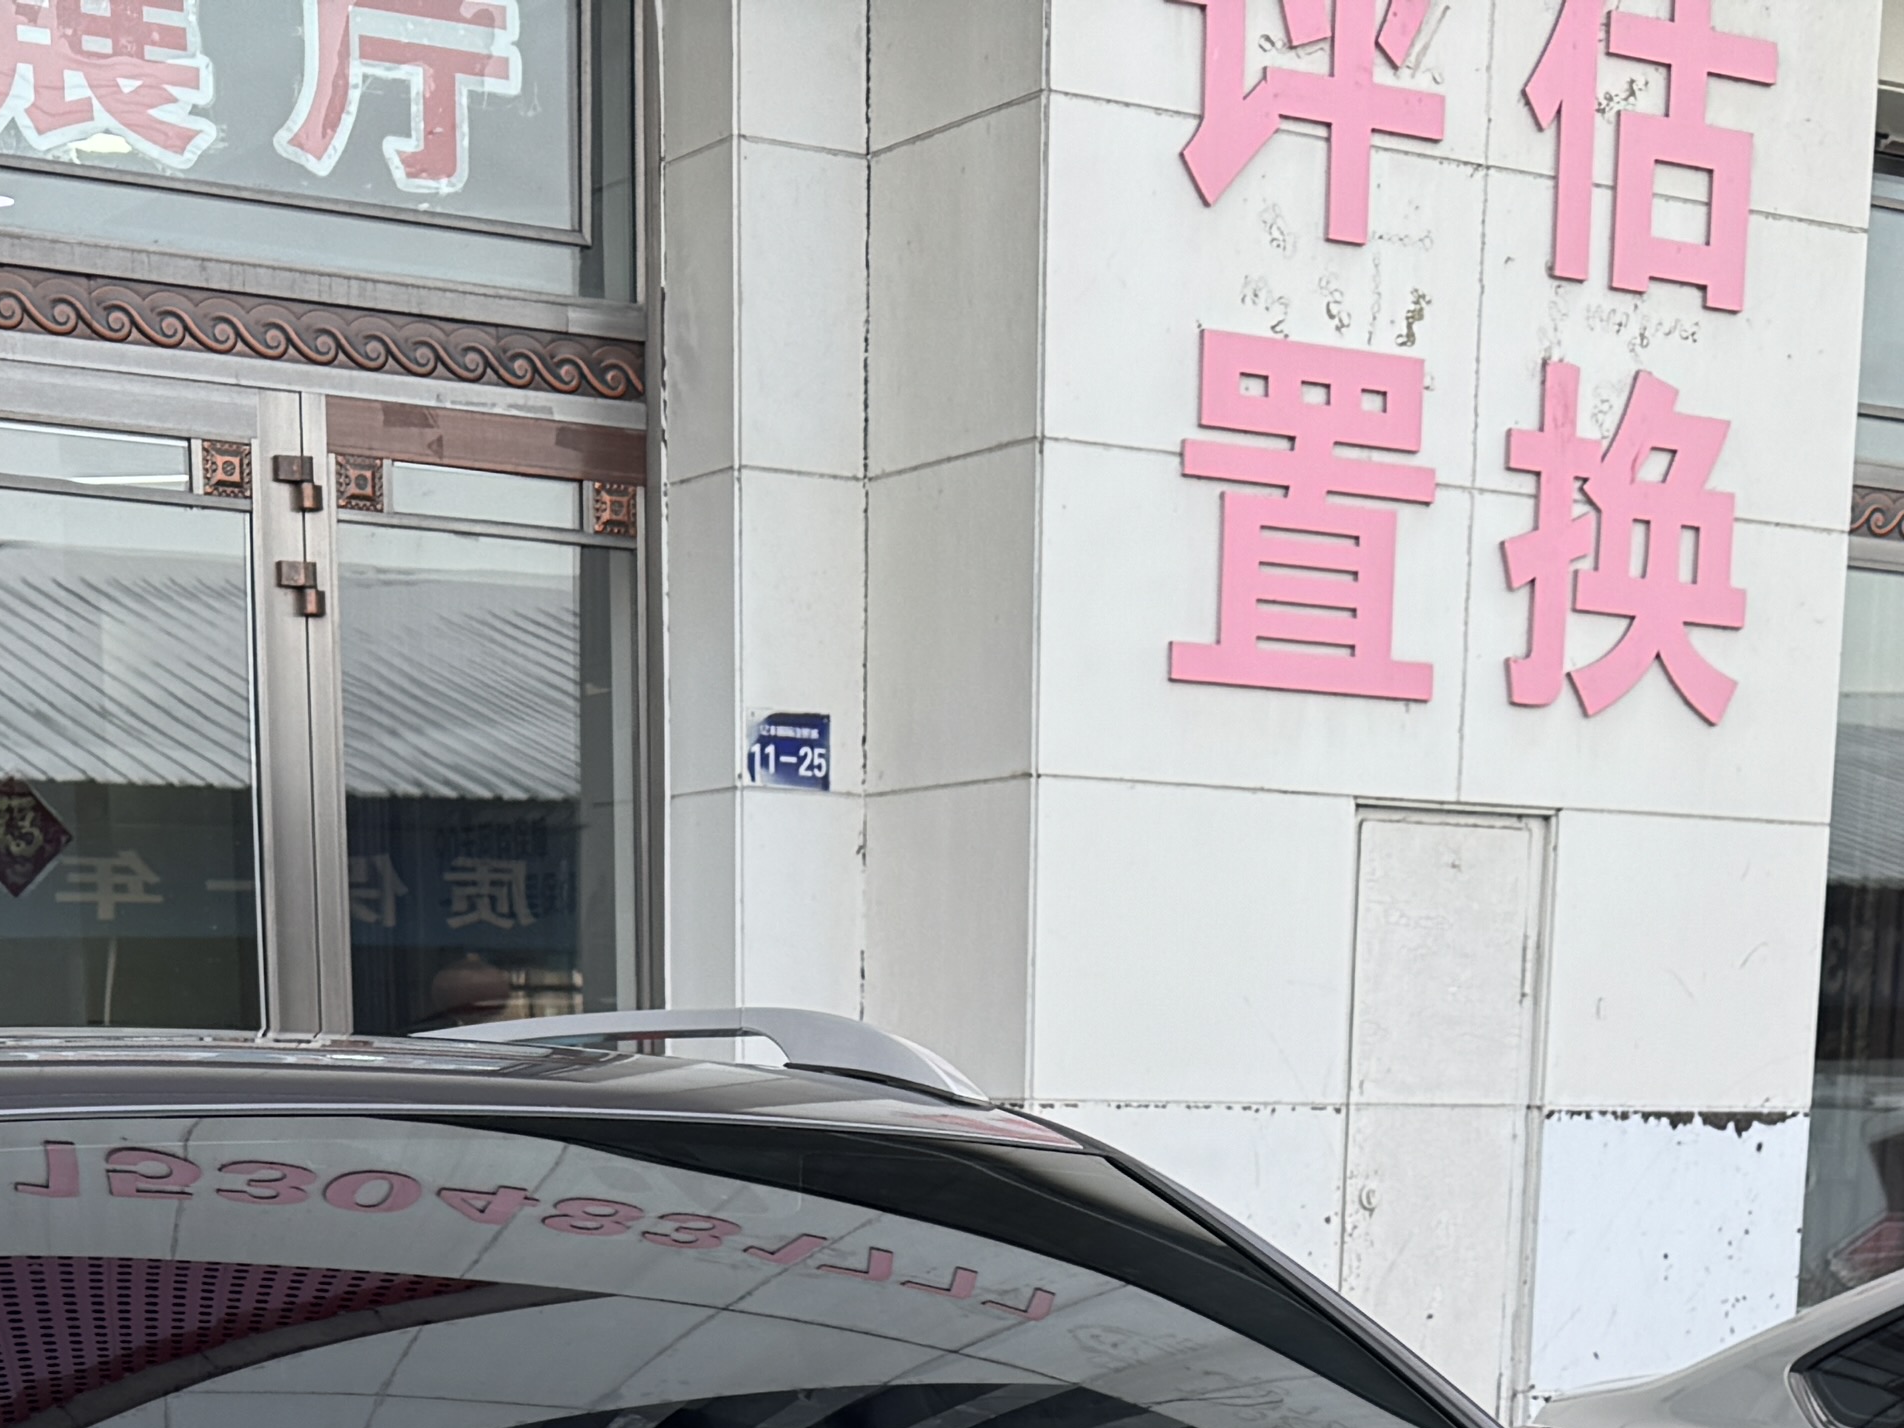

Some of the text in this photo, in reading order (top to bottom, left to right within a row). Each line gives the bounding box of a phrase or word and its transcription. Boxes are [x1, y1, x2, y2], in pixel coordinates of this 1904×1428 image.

[1168, 0, 1777, 312] 评估
[1169, 328, 1747, 726] 置换
[750, 743, 827, 784] 11-25
